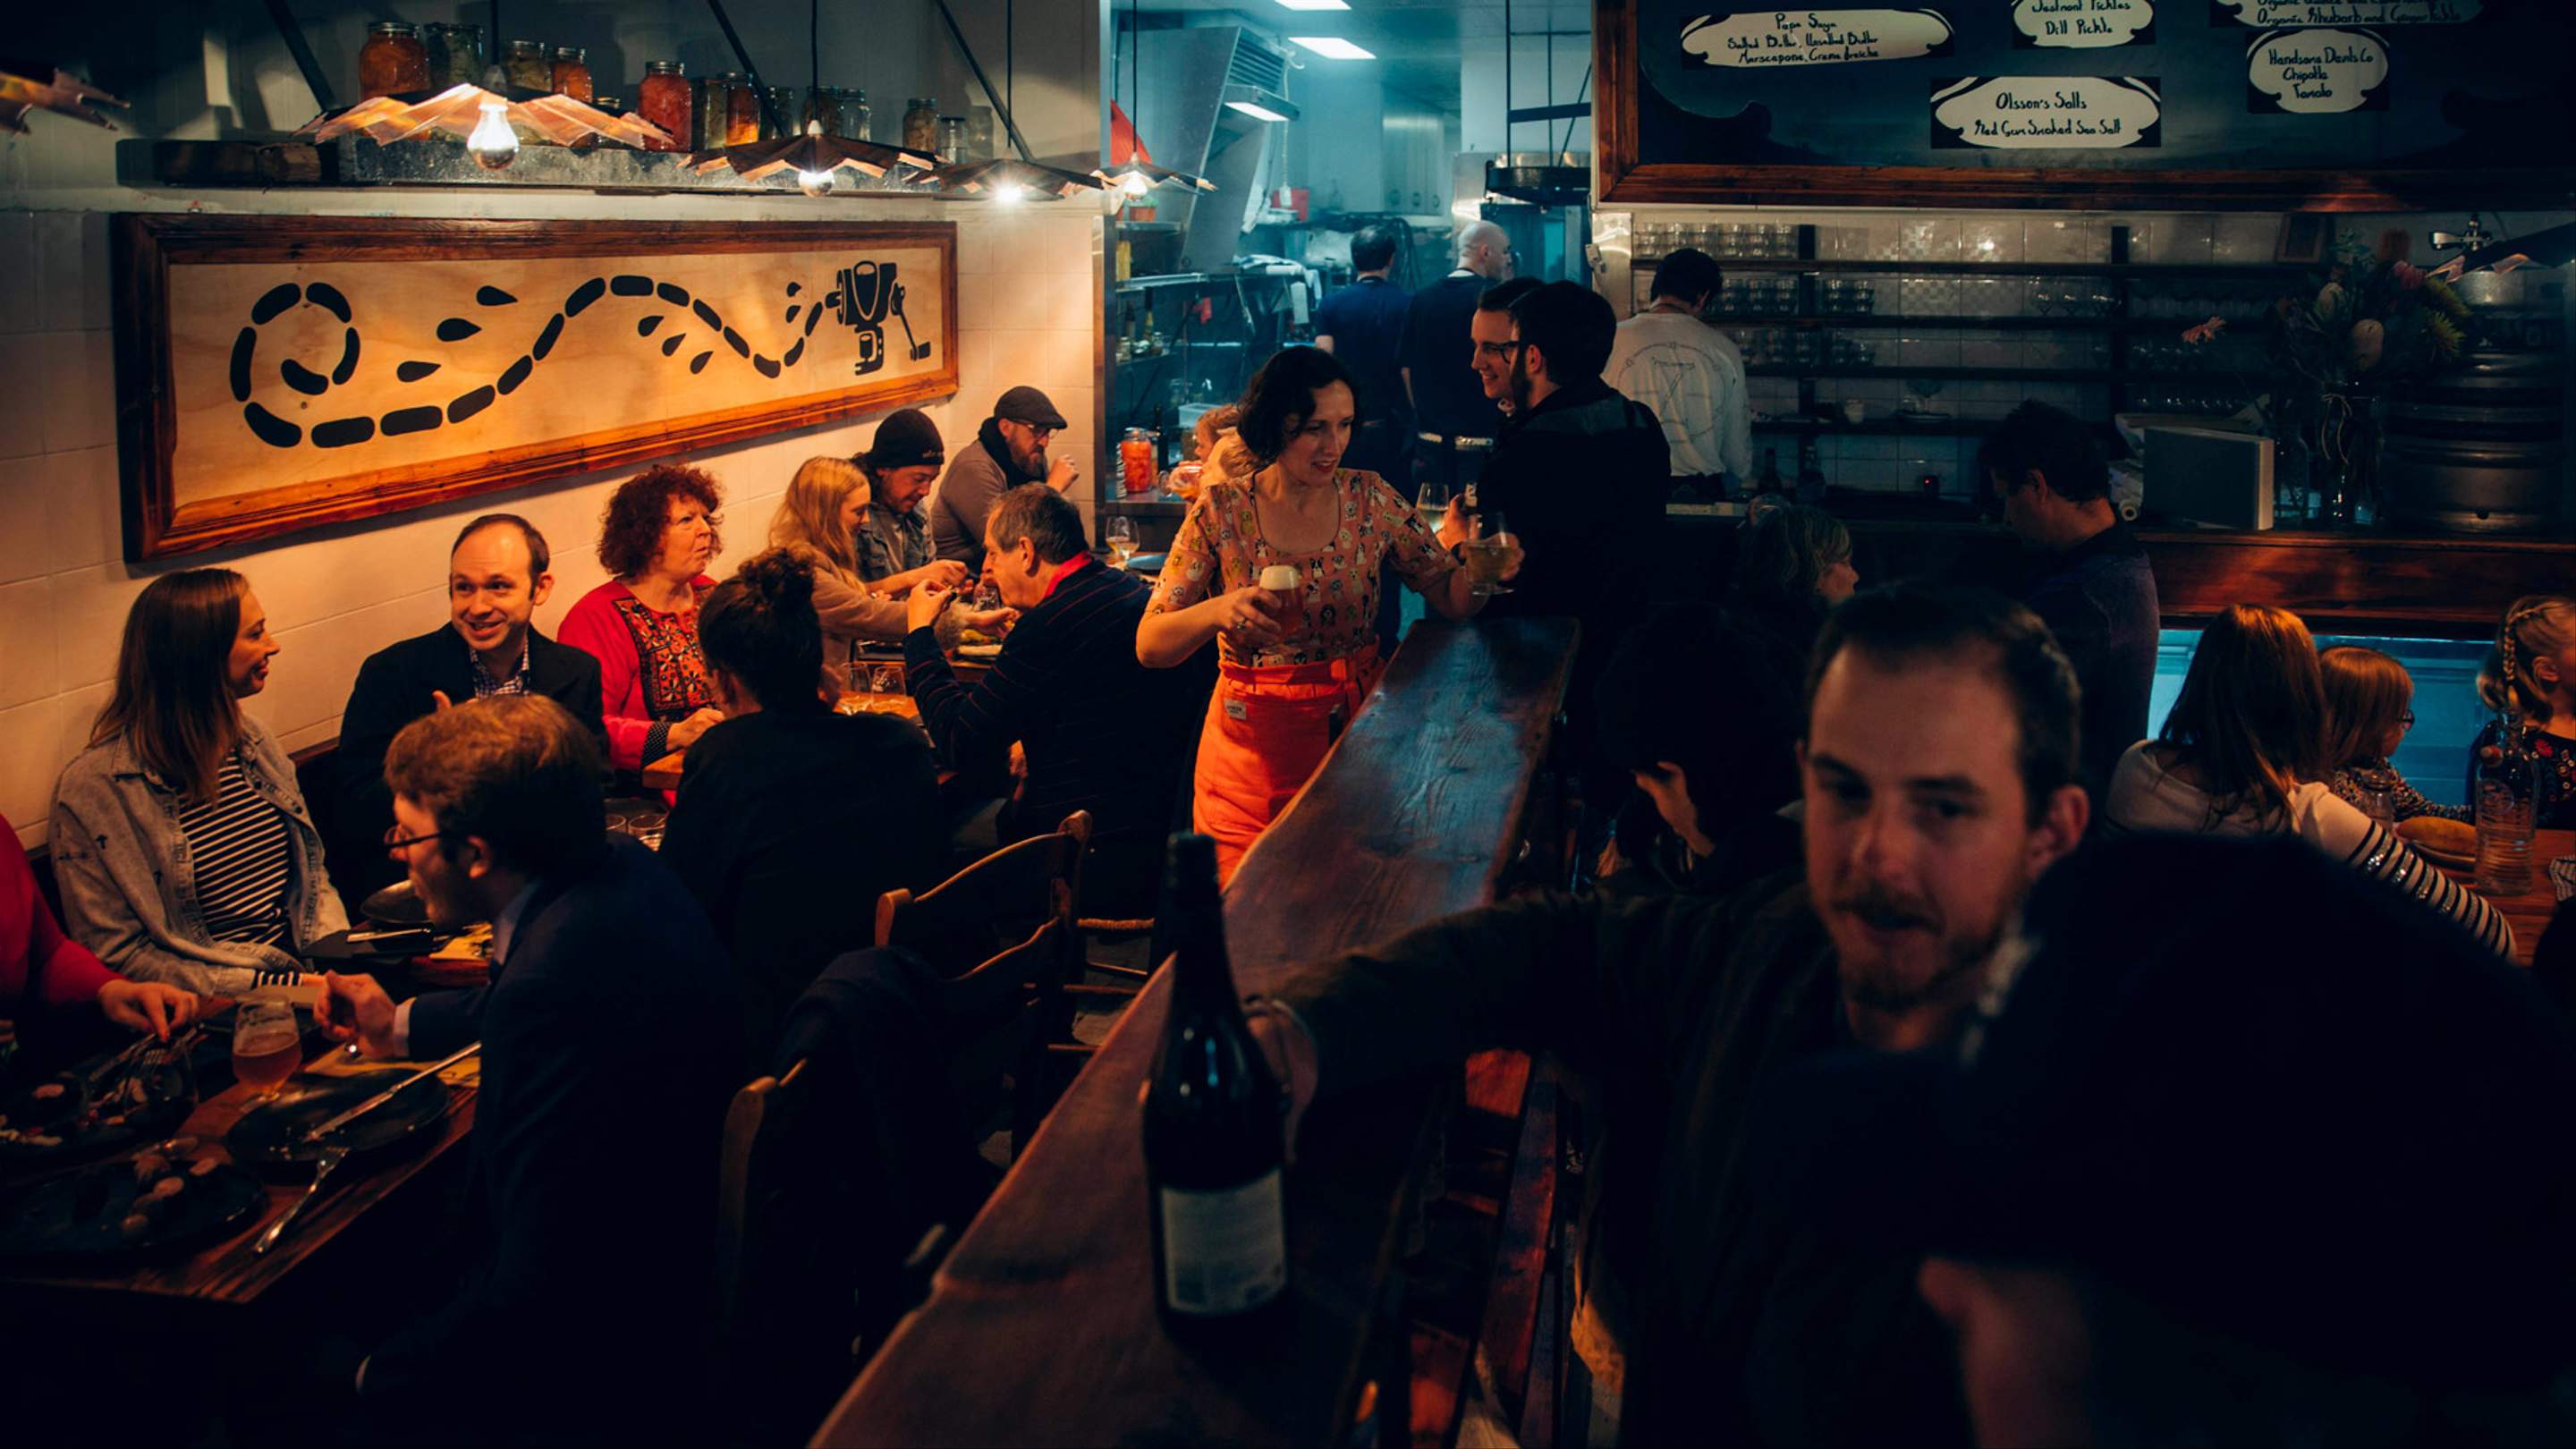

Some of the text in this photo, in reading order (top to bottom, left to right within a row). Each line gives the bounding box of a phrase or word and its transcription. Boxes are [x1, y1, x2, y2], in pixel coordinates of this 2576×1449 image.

[2045, 20, 2068, 35] Dill
[1996, 91, 2050, 110] Olsson's
[1974, 118, 1998, 136] Red
[2099, 118, 2122, 135] Salt
